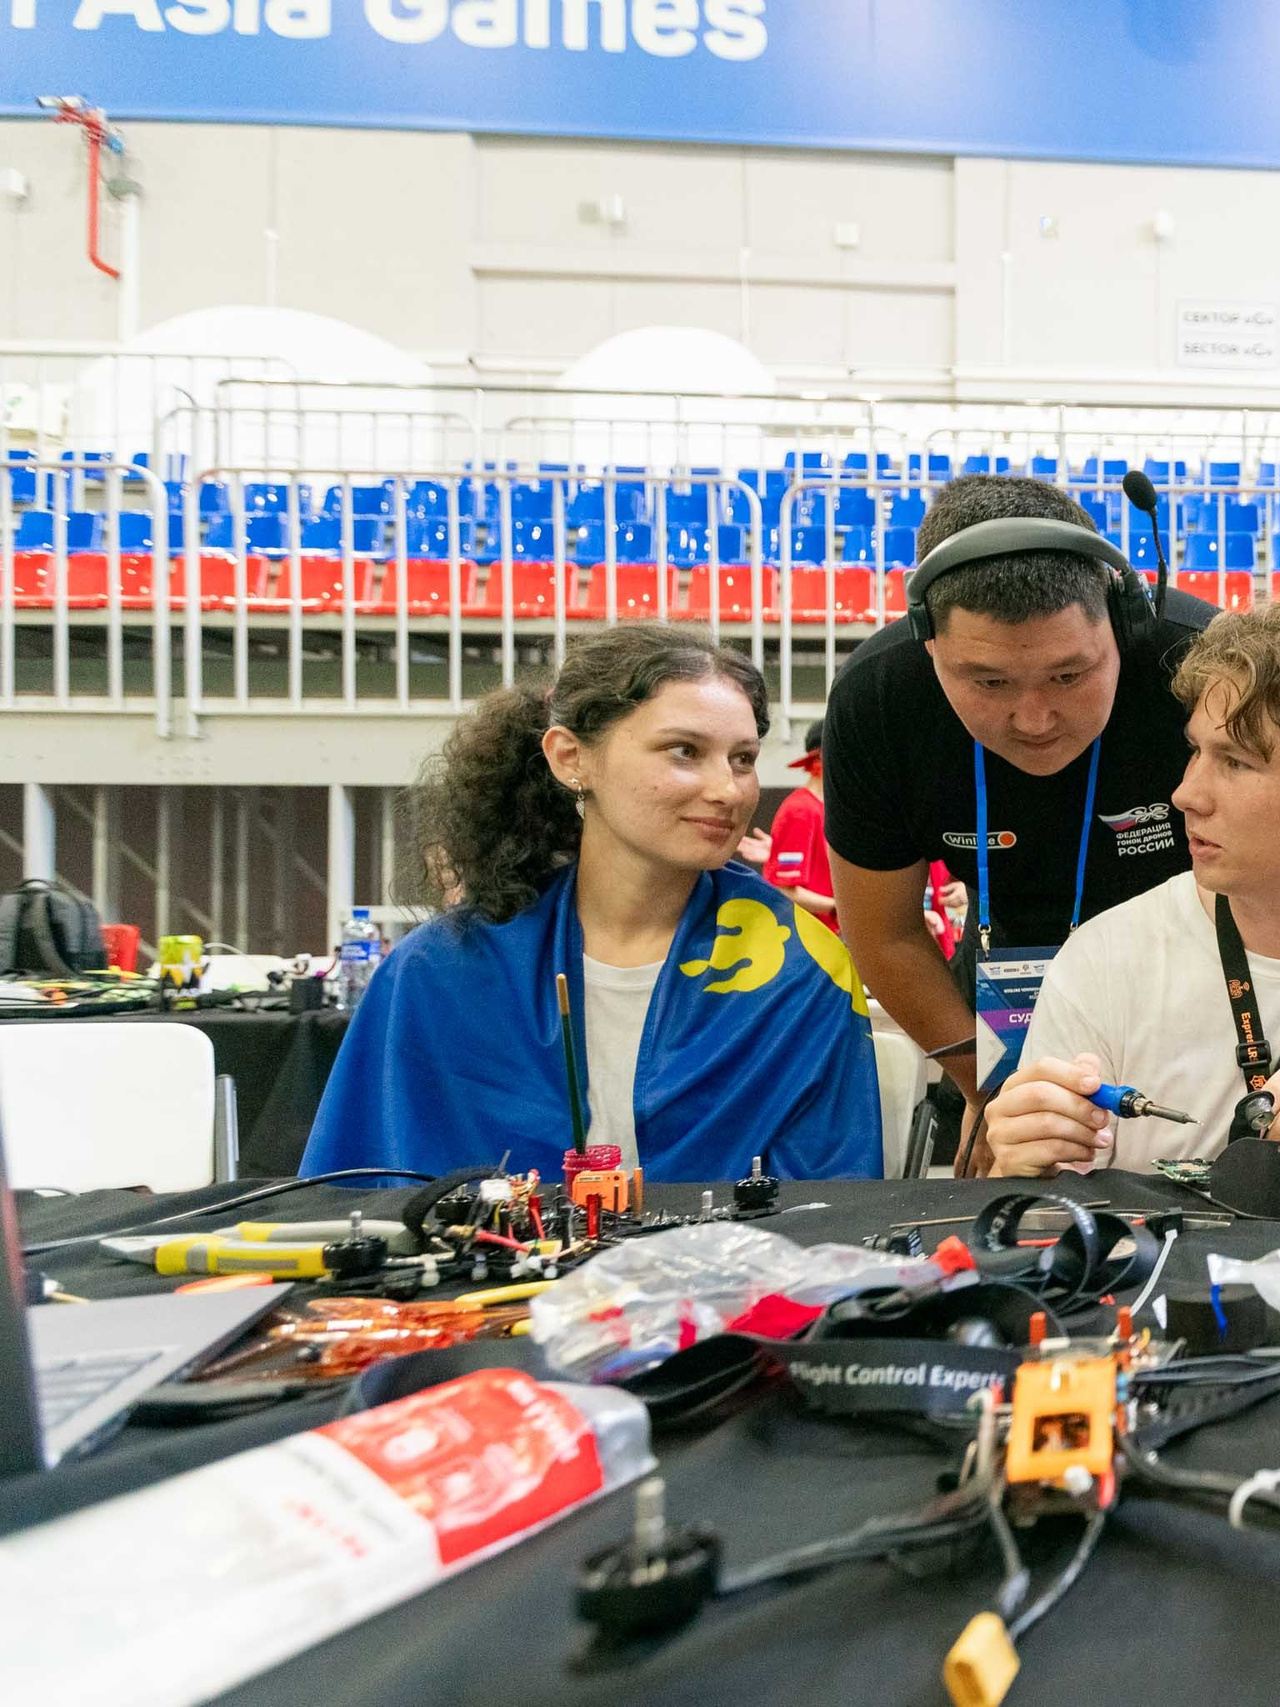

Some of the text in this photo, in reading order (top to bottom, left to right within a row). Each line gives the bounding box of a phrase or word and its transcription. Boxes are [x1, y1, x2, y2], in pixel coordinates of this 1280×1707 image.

[1116, 822, 1171, 839] ФЕДЕРАЦИЯ
[1117, 830, 1173, 846] ГОНОК ДРОНОВ
[1118, 837, 1175, 856] РОССИИ
[845, 1363, 927, 1386] Control
